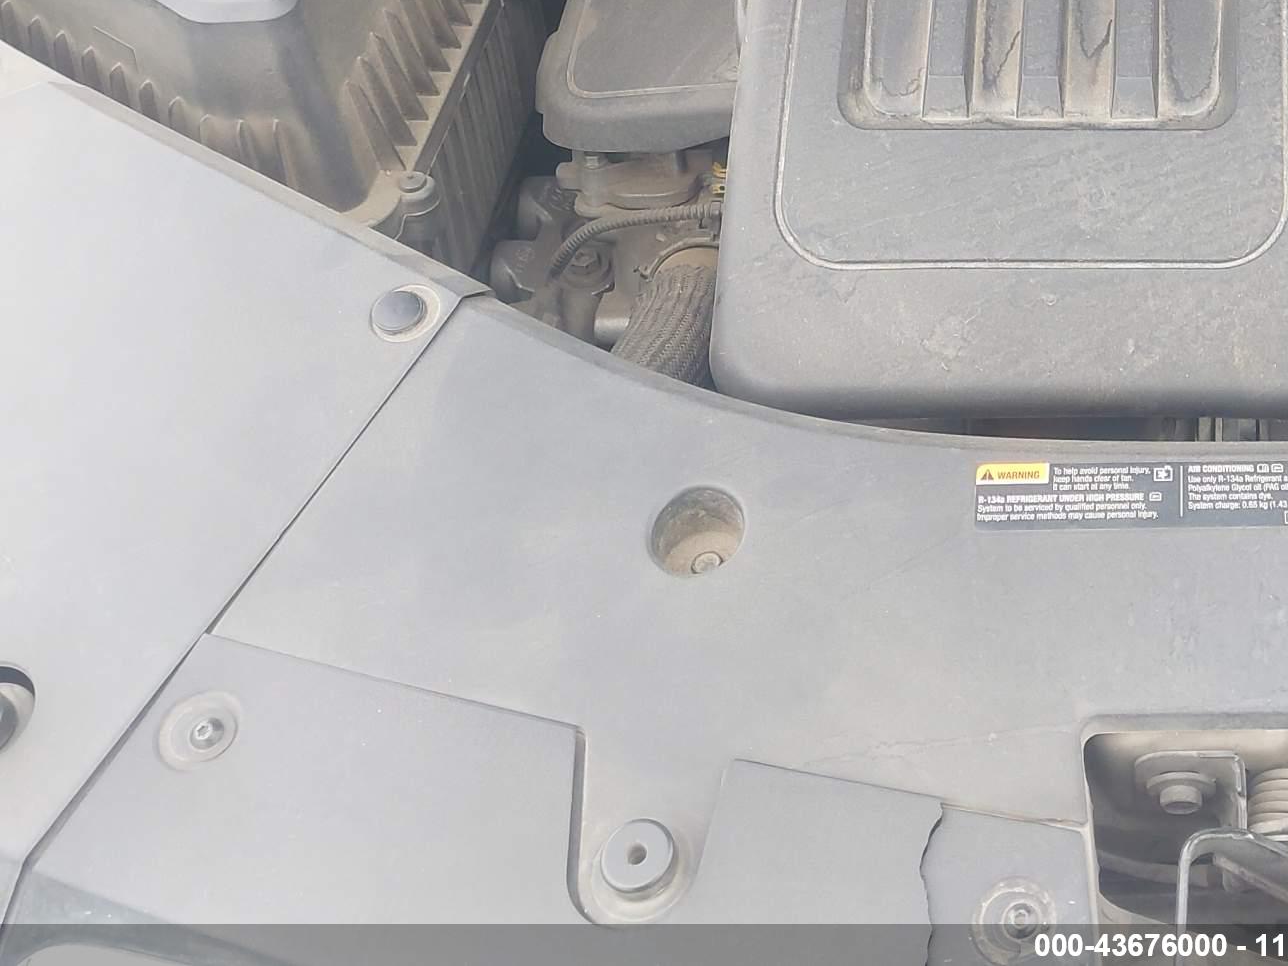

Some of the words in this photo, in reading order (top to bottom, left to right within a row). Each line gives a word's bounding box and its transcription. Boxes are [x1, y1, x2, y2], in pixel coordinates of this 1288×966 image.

[1063, 466, 1078, 476] help
[1080, 466, 1098, 474] avoid
[1100, 466, 1129, 476] personal
[1188, 465, 1201, 473] AIR
[997, 470, 1040, 480] WARNING
[1053, 476, 1070, 484] keep
[1072, 475, 1092, 483] hands
[1112, 474, 1120, 482] of
[1188, 475, 1201, 483] Use
[1202, 475, 1217, 484] only
[1244, 474, 1282, 484] Refrigerant
[1099, 483, 1112, 492] any
[1188, 484, 1230, 492] Polyalkylene
[1231, 483, 1252, 492] Glycol
[1253, 483, 1261, 491] oil
[978, 495, 1005, 503] R-134a
[1006, 495, 1058, 503] REFRIGERANT
[1059, 494, 1085, 502] UNDER
[1086, 494, 1104, 502] HIGH
[1105, 493, 1144, 501] PRESSURE
[1202, 493, 1227, 501] system
[1229, 492, 1257, 500] contains
[977, 505, 1004, 513] System
[1005, 504, 1012, 512] to
[1013, 504, 1023, 512] be
[1024, 503, 1053, 511] serviced
[1055, 503, 1063, 513] by
[1064, 502, 1095, 513] qualified
[1096, 502, 1130, 512] personnel
[1188, 501, 1213, 510] System
[1259, 501, 1268, 509] kg
[977, 514, 1008, 522] Improper
[1036, 512, 1066, 520] methods
[1068, 513, 1083, 521] may
[1106, 511, 1137, 520] personal
